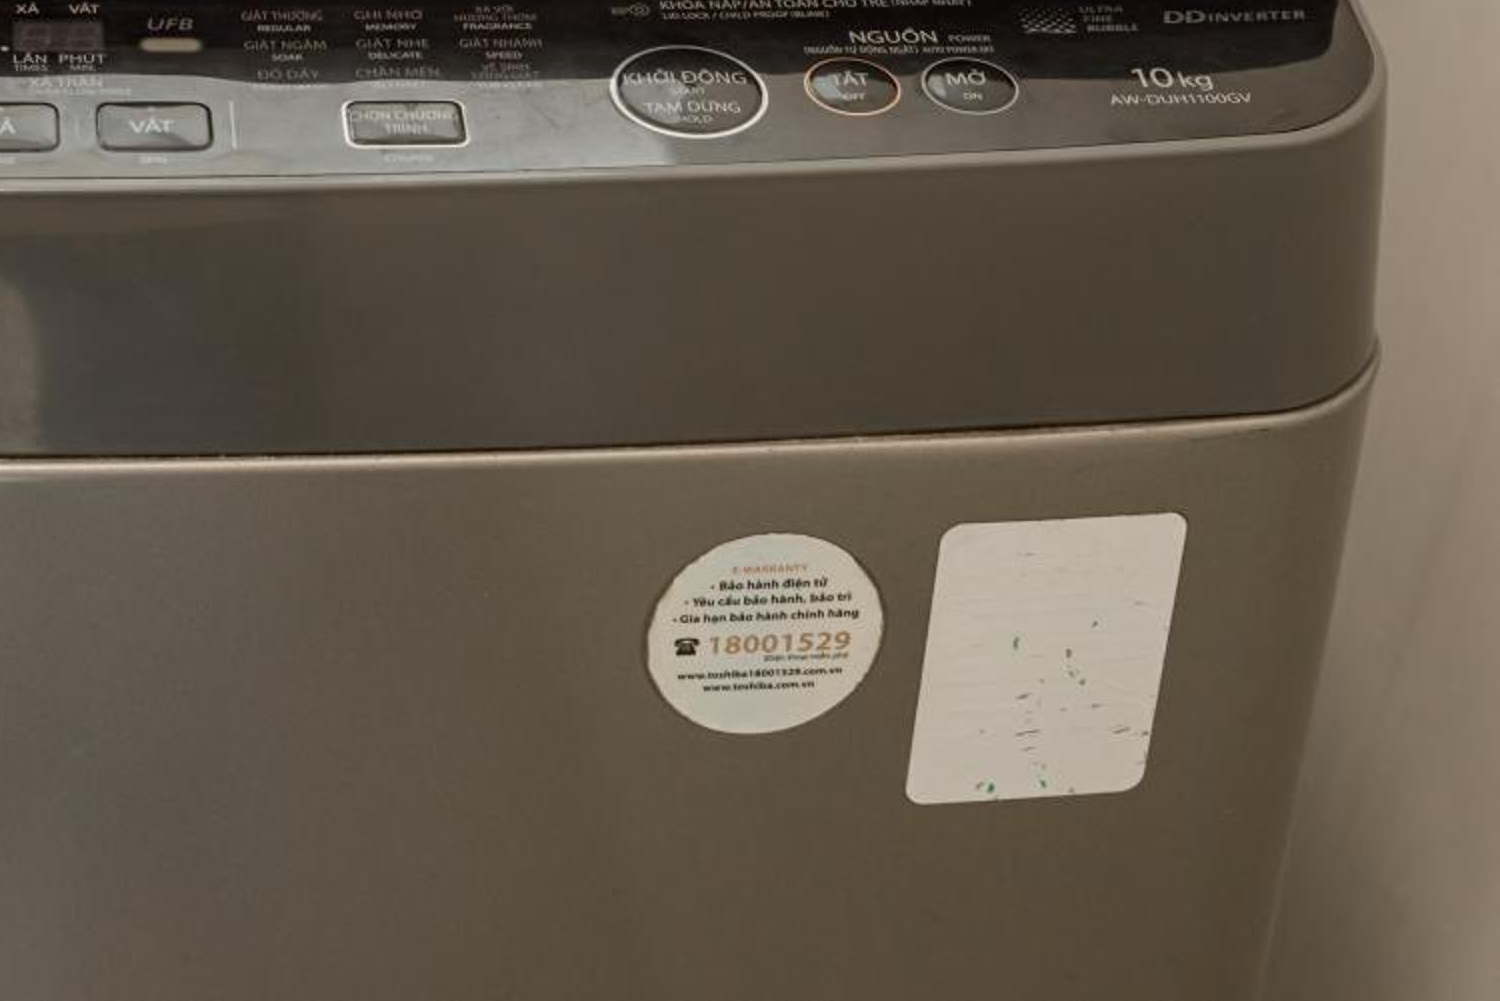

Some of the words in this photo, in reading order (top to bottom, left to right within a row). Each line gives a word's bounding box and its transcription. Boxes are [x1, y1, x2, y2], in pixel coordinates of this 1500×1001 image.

[146, 17, 194, 31] UFB
[1129, 66, 1174, 89] 10
[1177, 69, 1215, 92] kg
[1109, 91, 1252, 106] AW-DUH1100GV
[708, 630, 852, 655] 18001529
